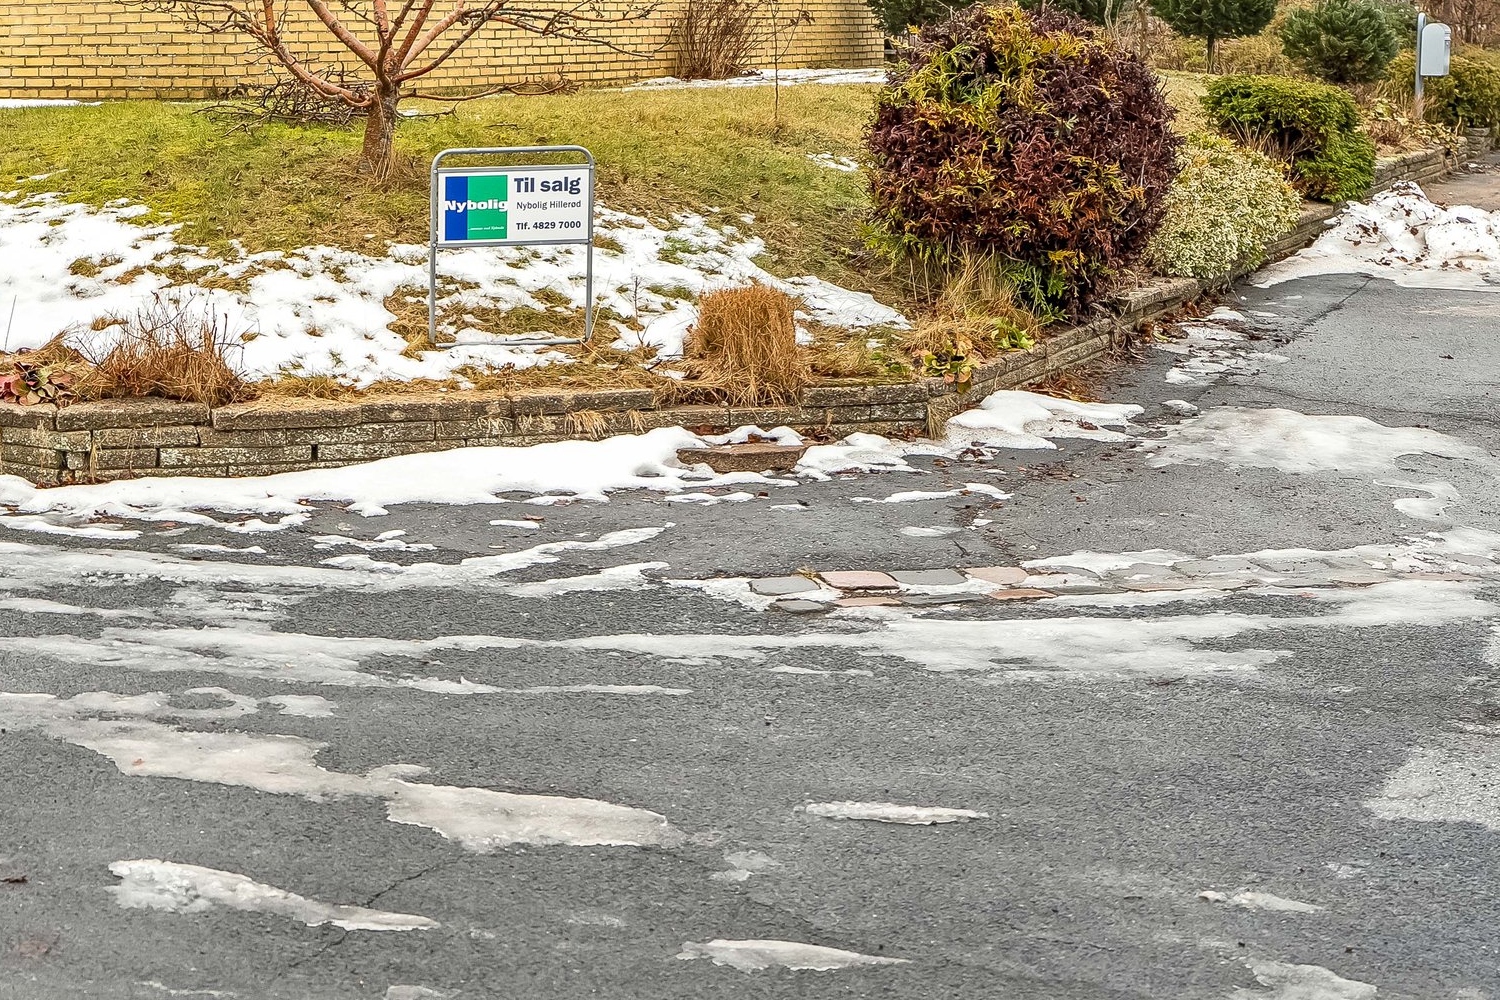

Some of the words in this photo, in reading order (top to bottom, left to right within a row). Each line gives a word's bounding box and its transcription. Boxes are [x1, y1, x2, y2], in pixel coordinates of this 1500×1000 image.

[514, 177, 535, 193] Til
[540, 176, 581, 195] salg
[444, 199, 509, 213] Nybolig
[516, 201, 548, 211] Nybolig
[549, 200, 581, 209] Hillerød
[516, 222, 531, 230] Tlf.
[532, 221, 556, 230] 4829
[558, 220, 581, 229] 7000
